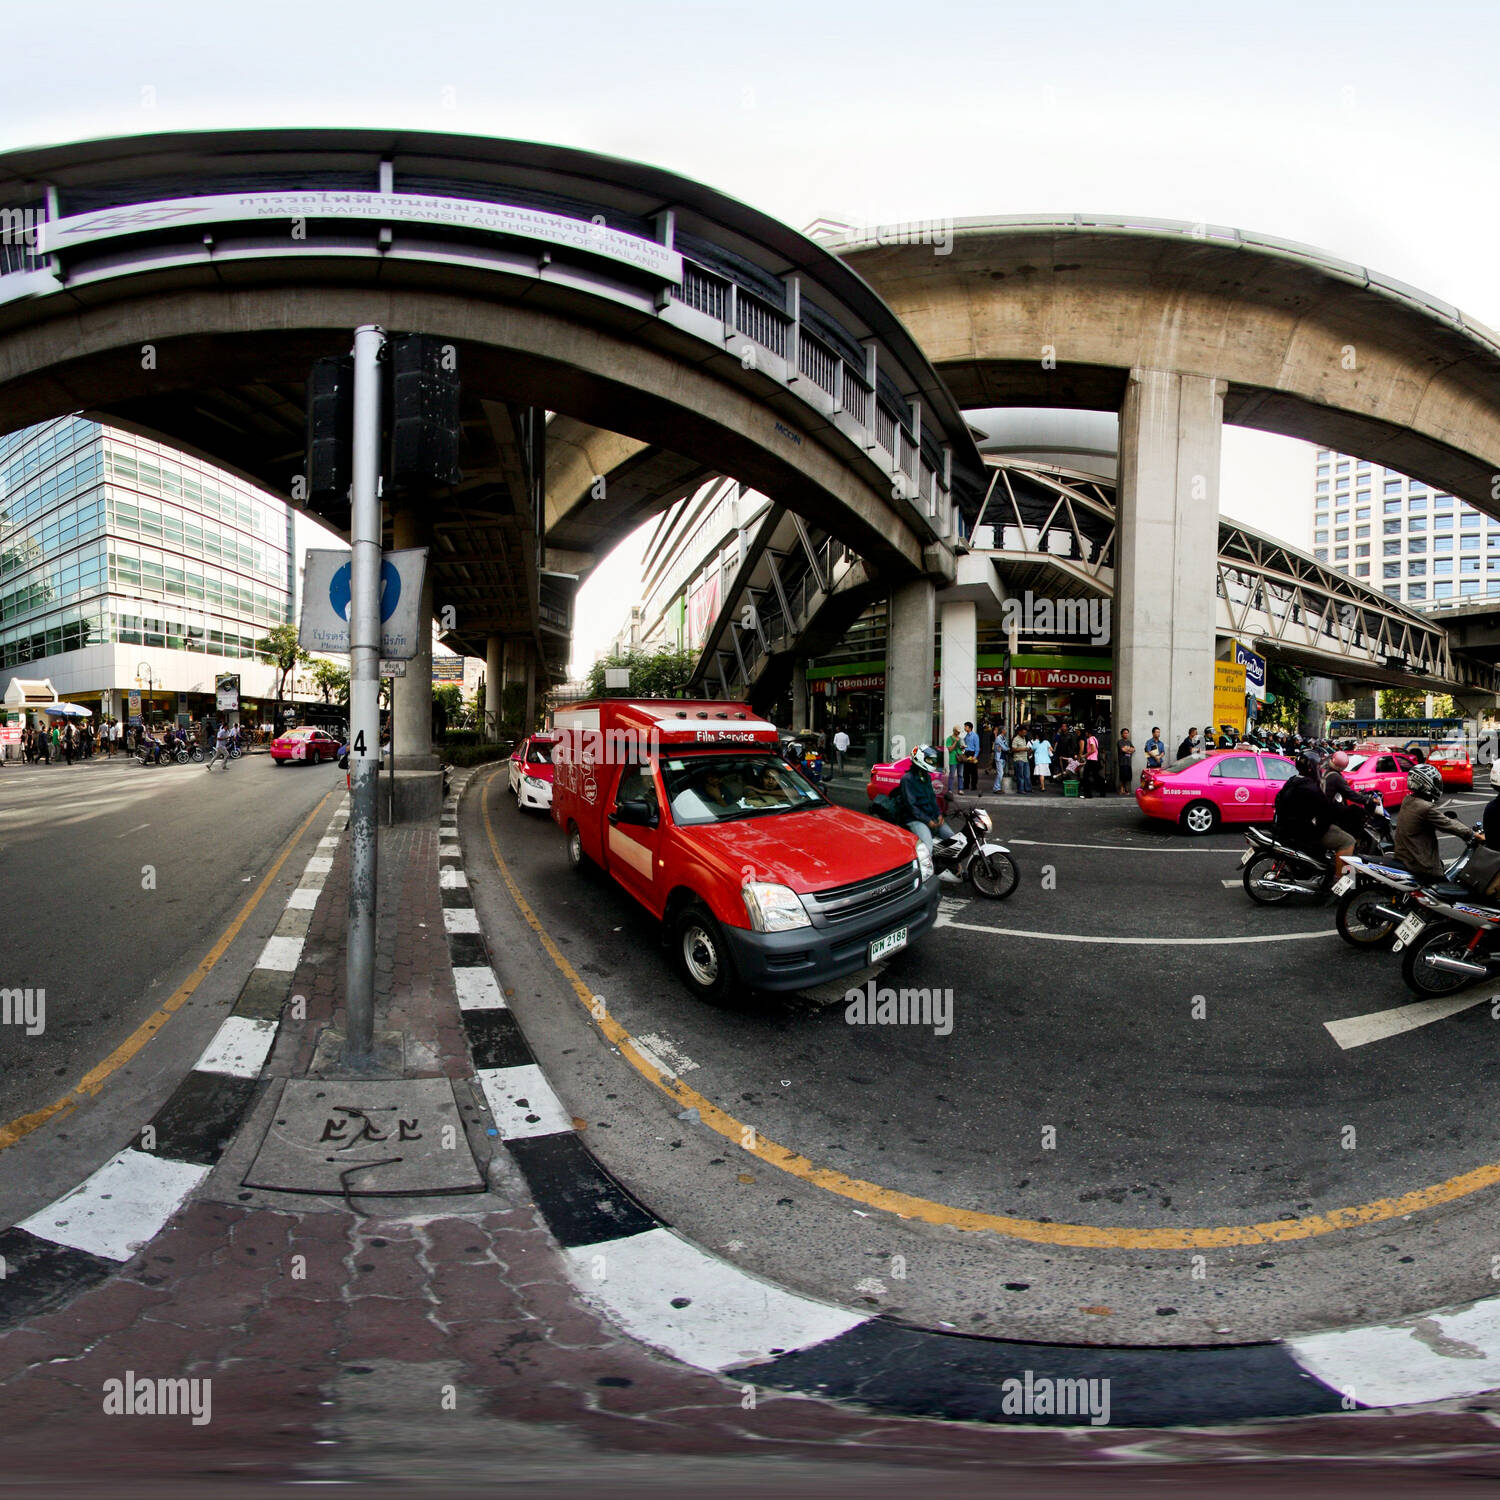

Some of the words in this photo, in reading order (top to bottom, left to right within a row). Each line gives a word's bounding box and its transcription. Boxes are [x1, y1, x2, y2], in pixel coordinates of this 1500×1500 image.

[258, 206, 313, 215] MASS
[321, 206, 380, 215] RAPID
[388, 208, 467, 223] TRANSIT
[472, 217, 569, 240] AUTHORITY
[572, 235, 592, 246] OF
[598, 242, 660, 269] THAILAND
[835, 677, 884, 688] cDonald's
[353, 729, 367, 757] 4
[886, 930, 907, 947] 2188
